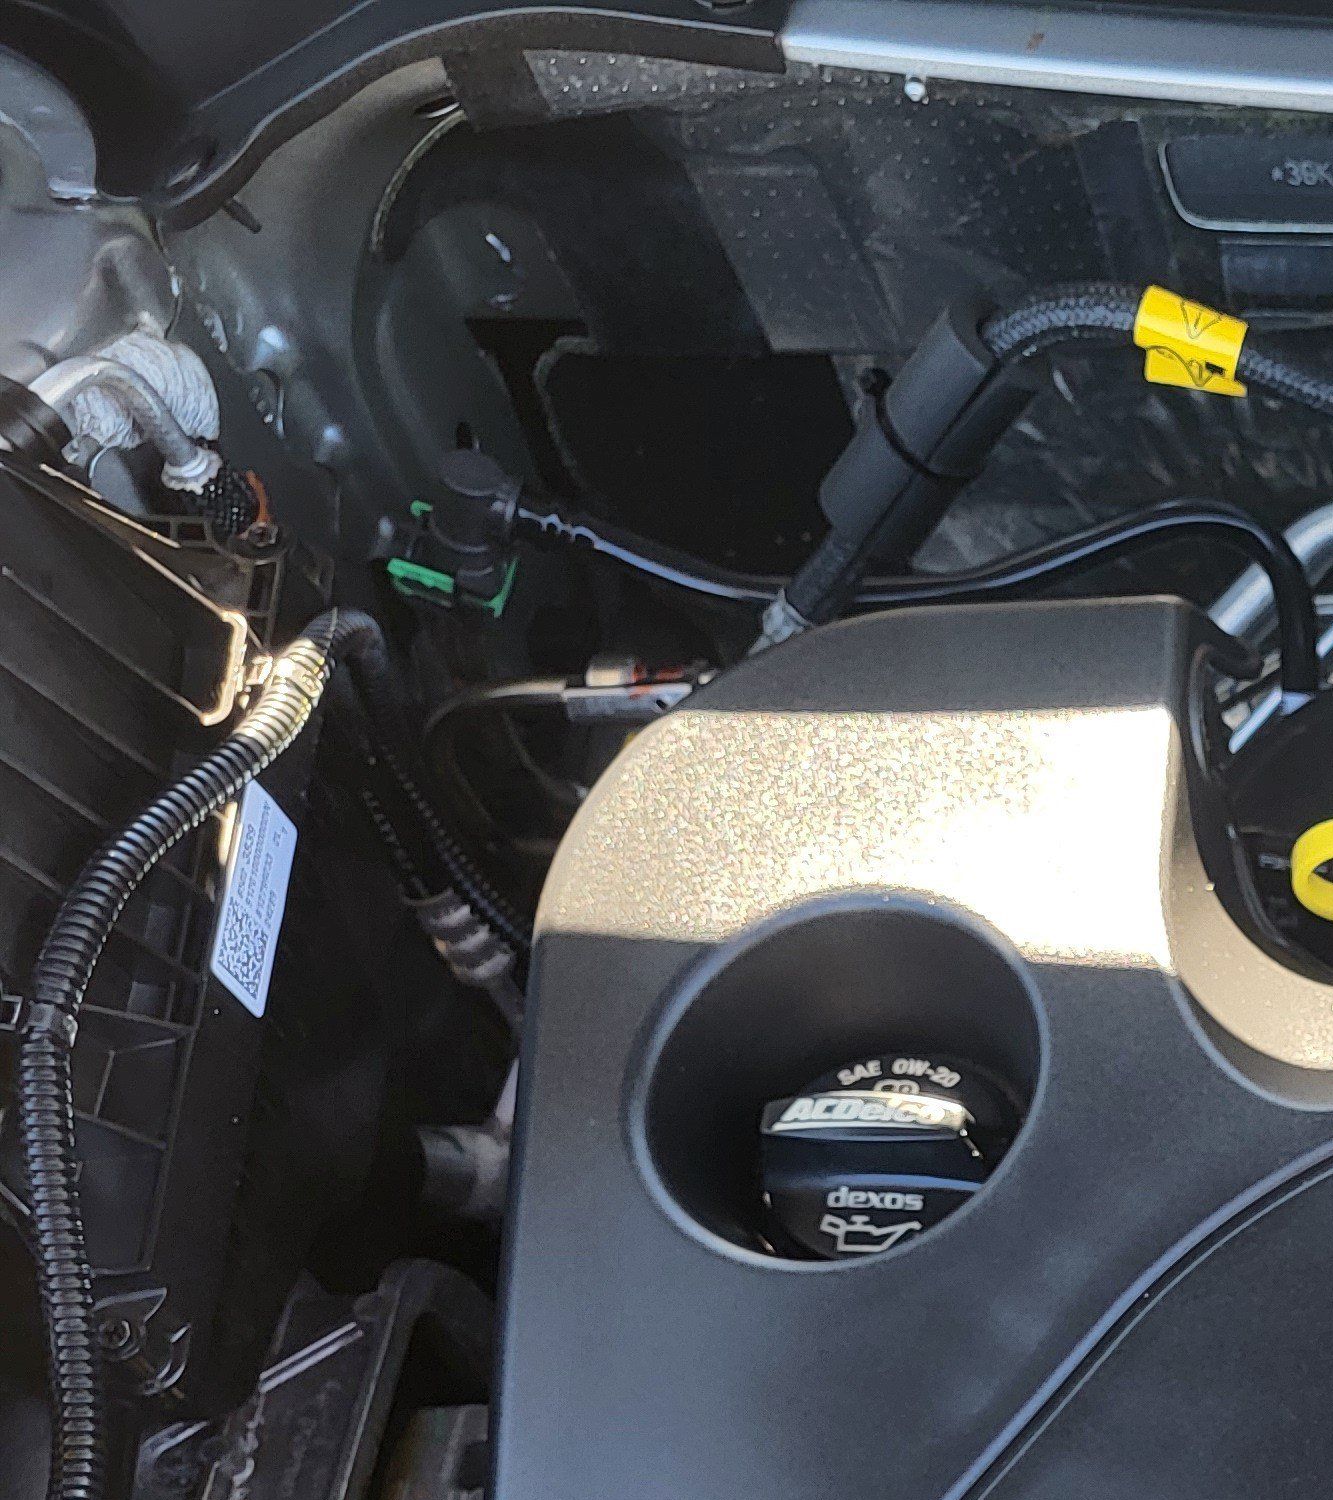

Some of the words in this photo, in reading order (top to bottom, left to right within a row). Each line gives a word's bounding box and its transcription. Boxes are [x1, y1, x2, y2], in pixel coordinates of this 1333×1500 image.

[836, 1060, 883, 1086] SAE
[891, 1058, 962, 1088] 0W-20
[826, 1186, 924, 1211] dexos
